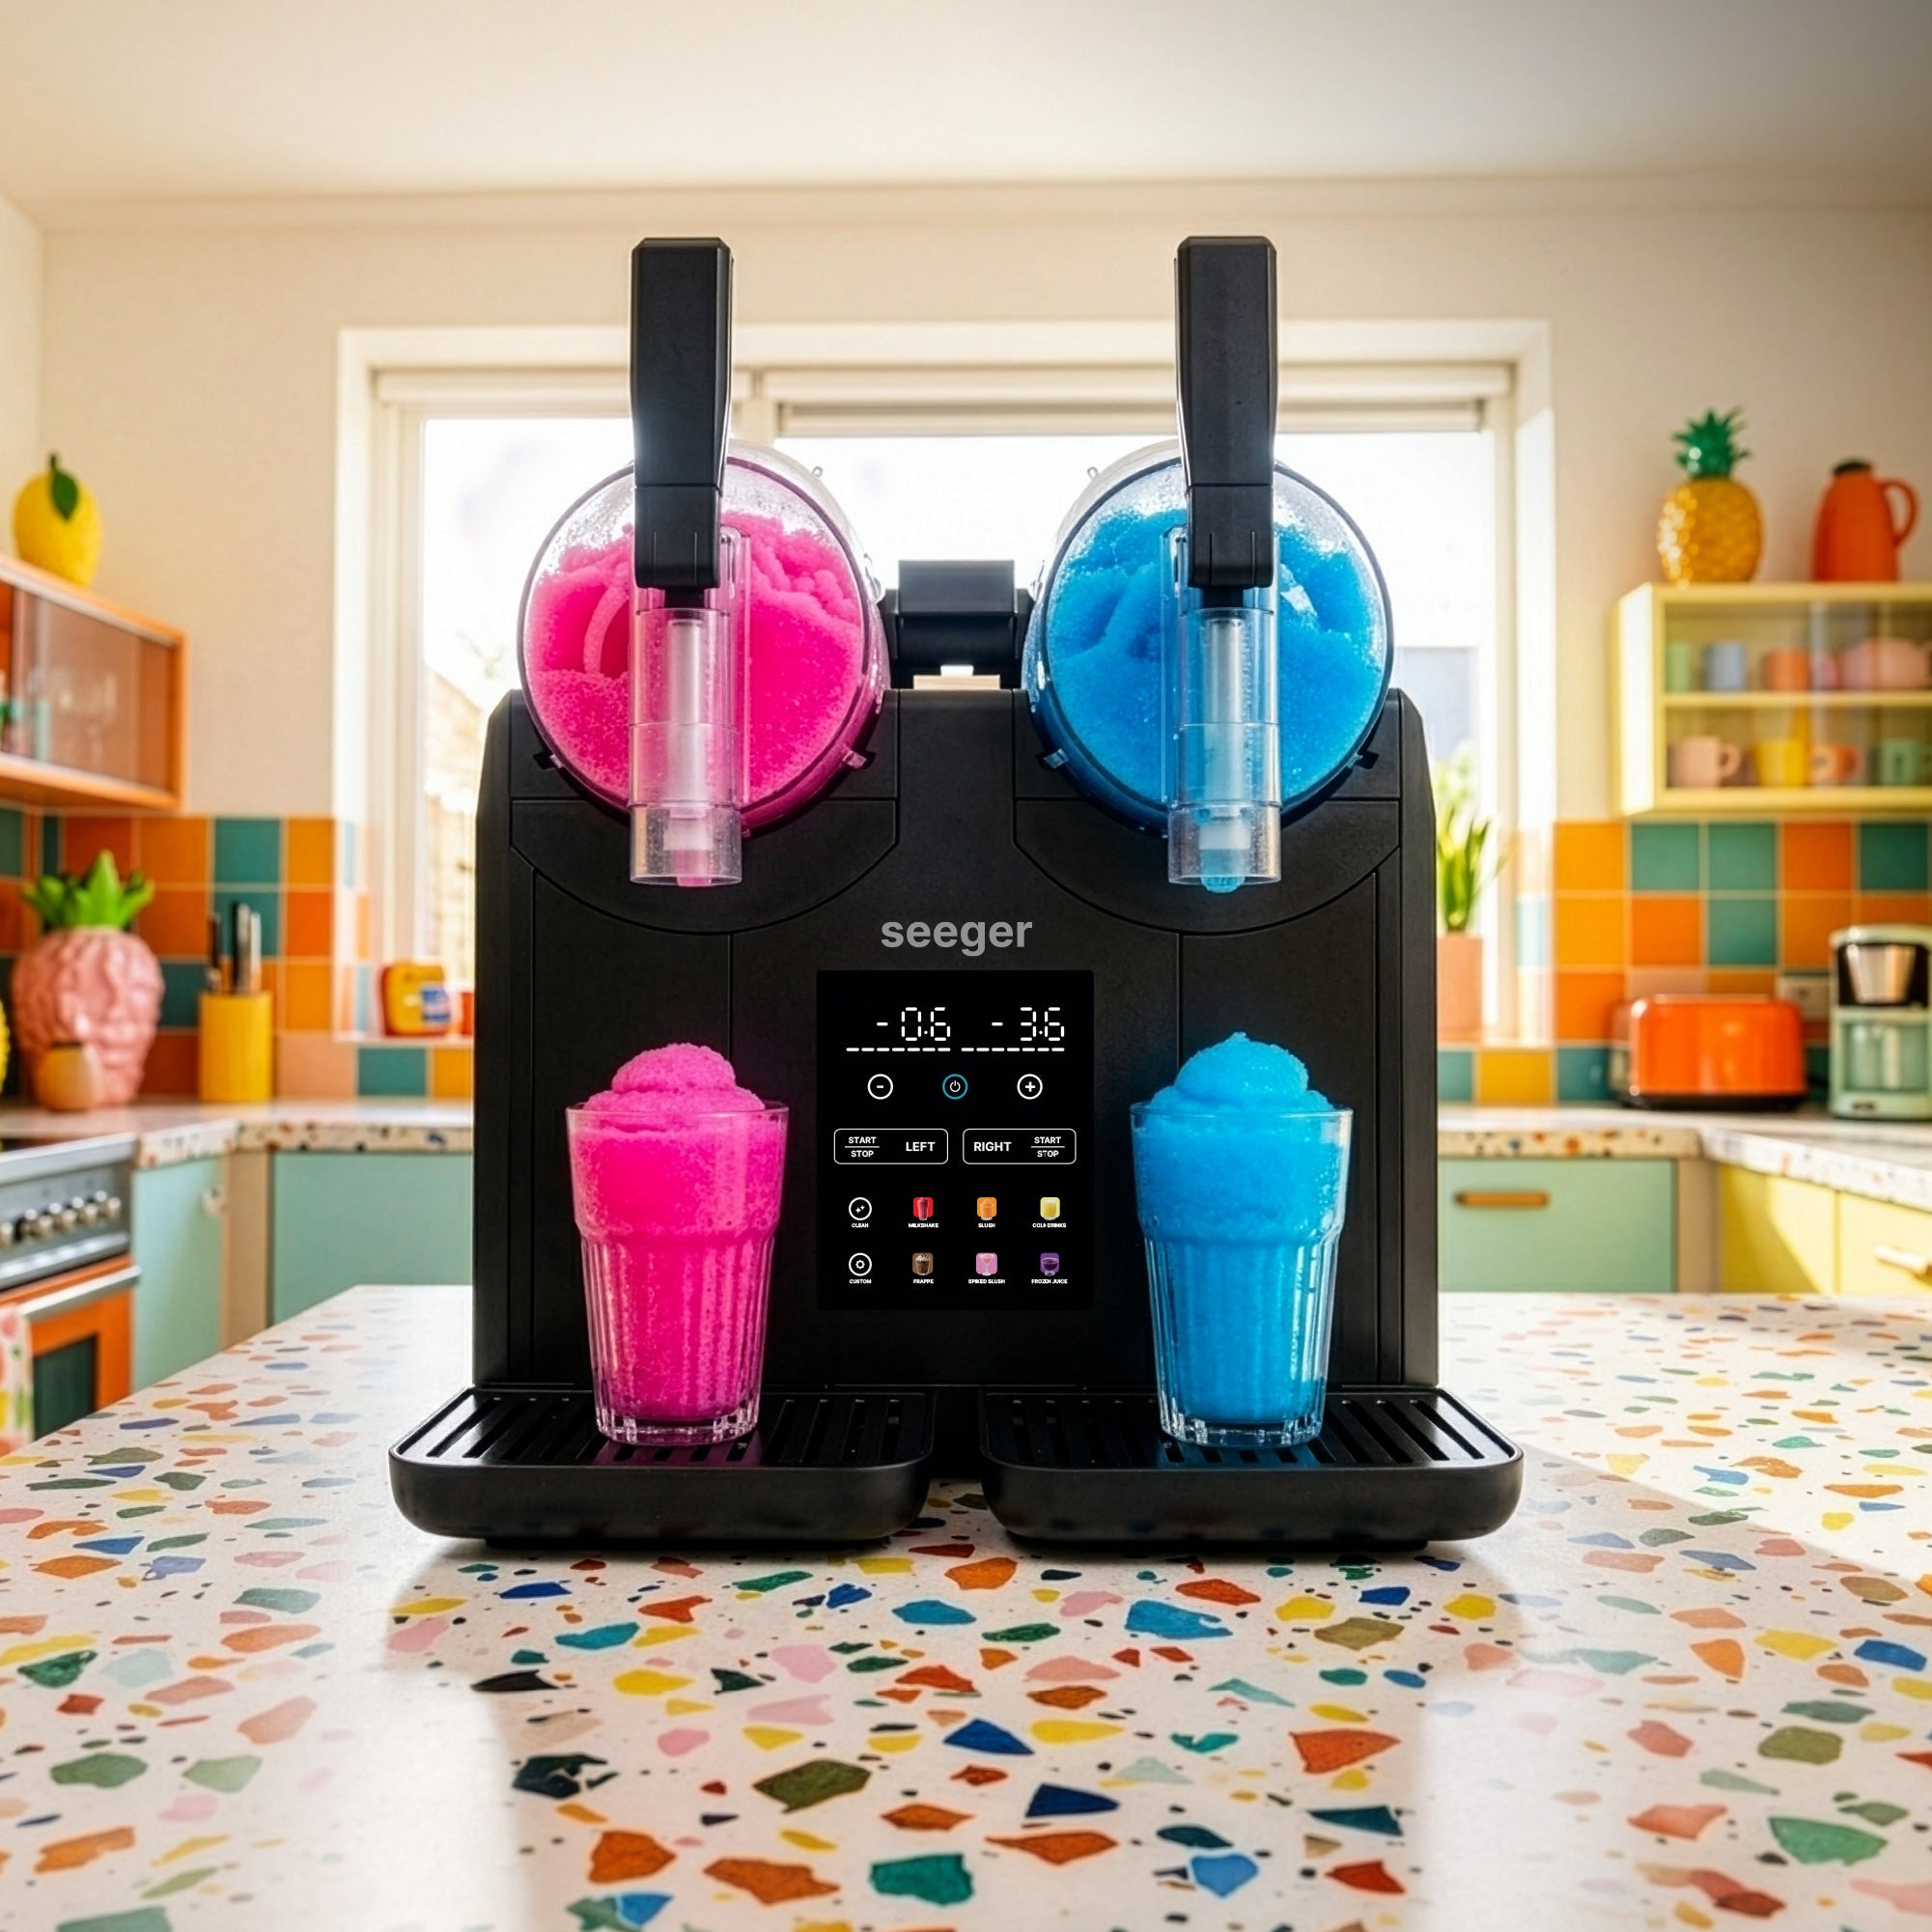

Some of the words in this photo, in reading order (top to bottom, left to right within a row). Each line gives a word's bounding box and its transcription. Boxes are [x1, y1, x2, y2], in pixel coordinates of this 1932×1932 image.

[881, 921, 1033, 957] seeger
[848, 1135, 878, 1144] START
[1033, 1135, 1062, 1144] START
[905, 1141, 937, 1152] LEFT
[973, 1141, 1013, 1152] RIGHT
[851, 1149, 875, 1158] STOP
[1036, 1149, 1060, 1158] STOP
